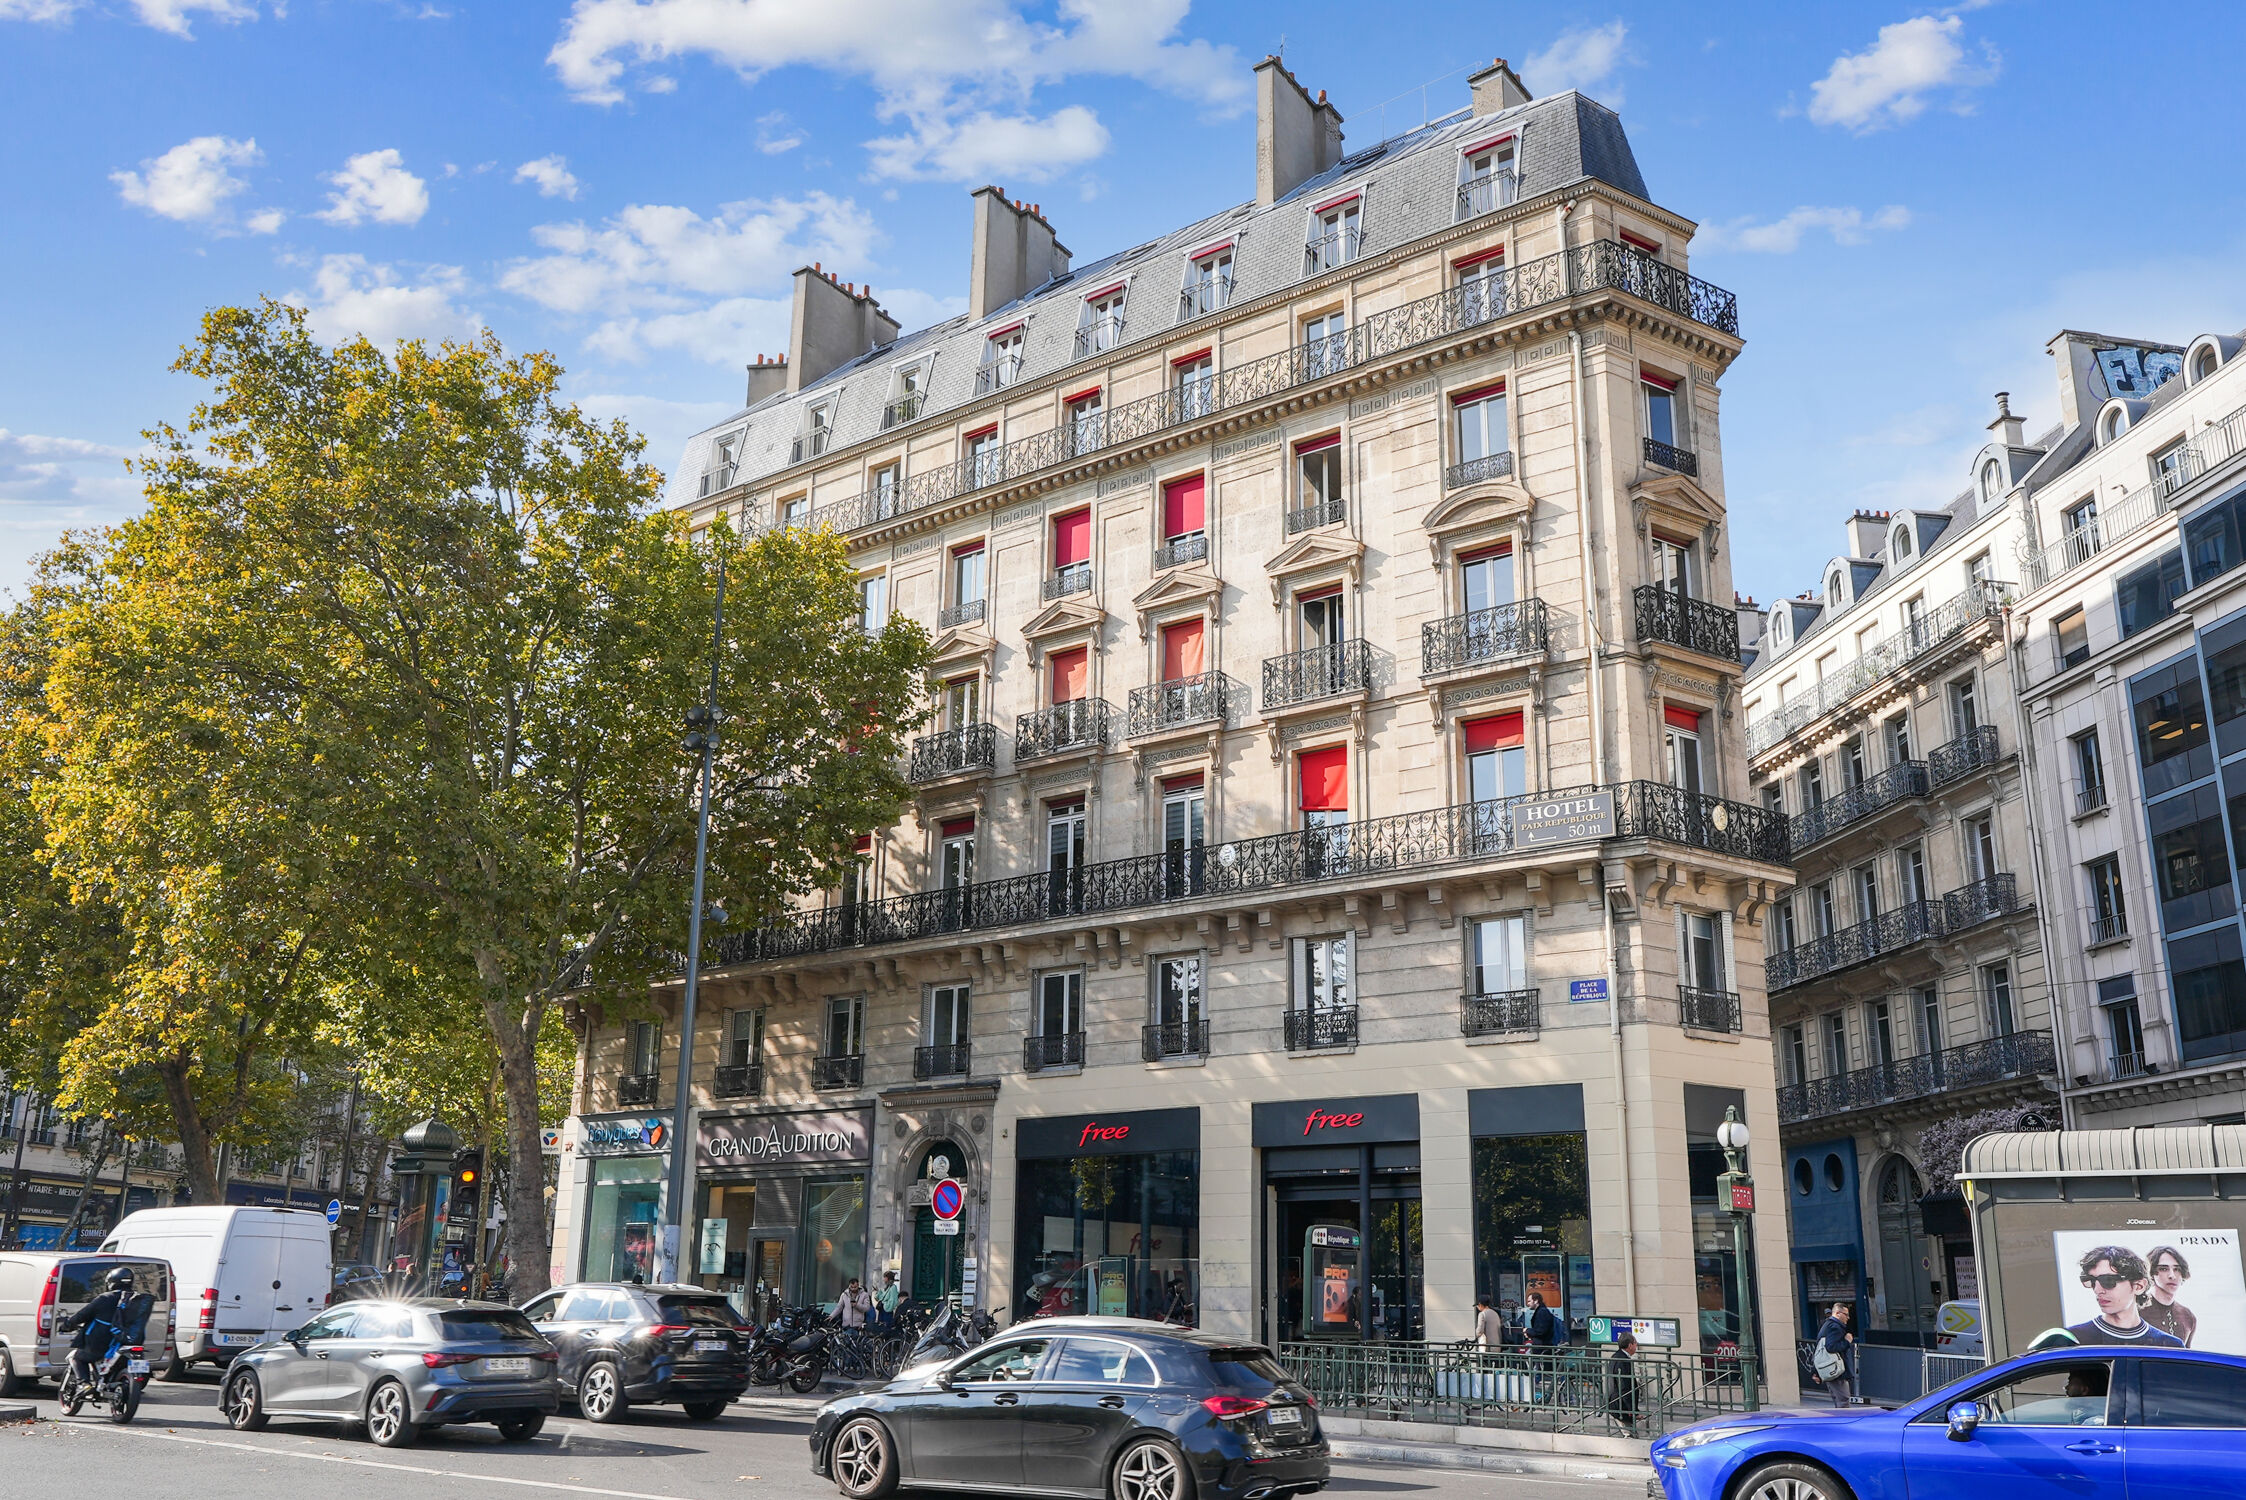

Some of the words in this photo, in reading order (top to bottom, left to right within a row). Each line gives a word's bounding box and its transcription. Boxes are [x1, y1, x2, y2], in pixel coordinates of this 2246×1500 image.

[1526, 798, 1600, 821] HOTEL
[1521, 822, 1543, 831] PAIX
[1545, 812, 1607, 827] REPUBLIQUE
[1568, 824, 1586, 837] 50
[1589, 824, 1602, 834] m
[1571, 992, 1607, 1000] RÉPUBLIQUE
[1303, 1108, 1364, 1136] free
[588, 1125, 640, 1146] bouygues
[1078, 1122, 1130, 1147] free
[59, 1187, 82, 1197] MEDICA
[81, 1229, 107, 1238] SOMMEIL
[1327, 1235, 1350, 1245] République
[2180, 1236, 2229, 1245] PRADA
[1324, 1267, 1349, 1279] PRO
